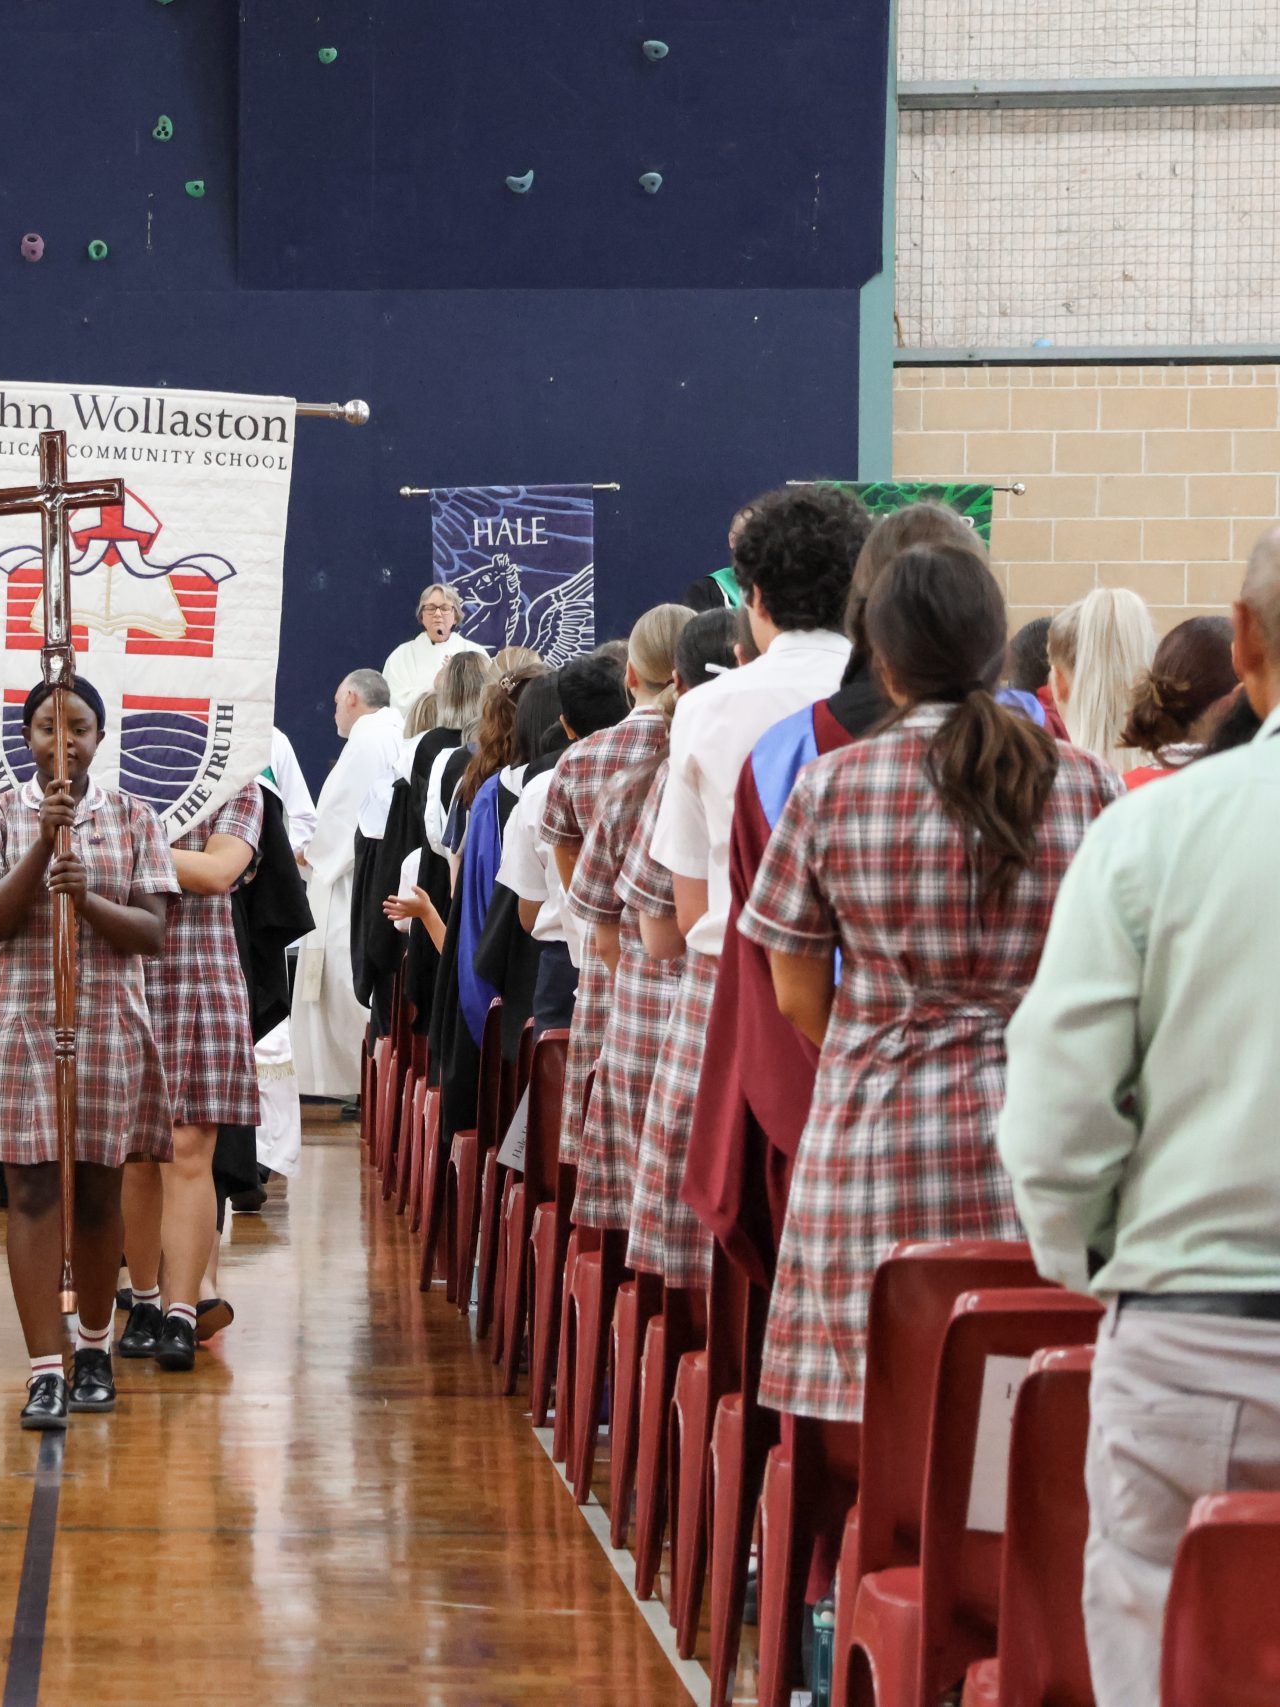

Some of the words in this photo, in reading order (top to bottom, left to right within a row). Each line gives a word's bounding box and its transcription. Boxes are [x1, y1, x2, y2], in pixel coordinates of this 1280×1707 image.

[70, 393, 289, 444] Wollaston
[67, 444, 195, 464] COMMUNITY
[203, 451, 288, 471] SCHOOL
[473, 516, 549, 546] HALE
[170, 783, 212, 827] THE
[202, 704, 234, 783] TRUTH
